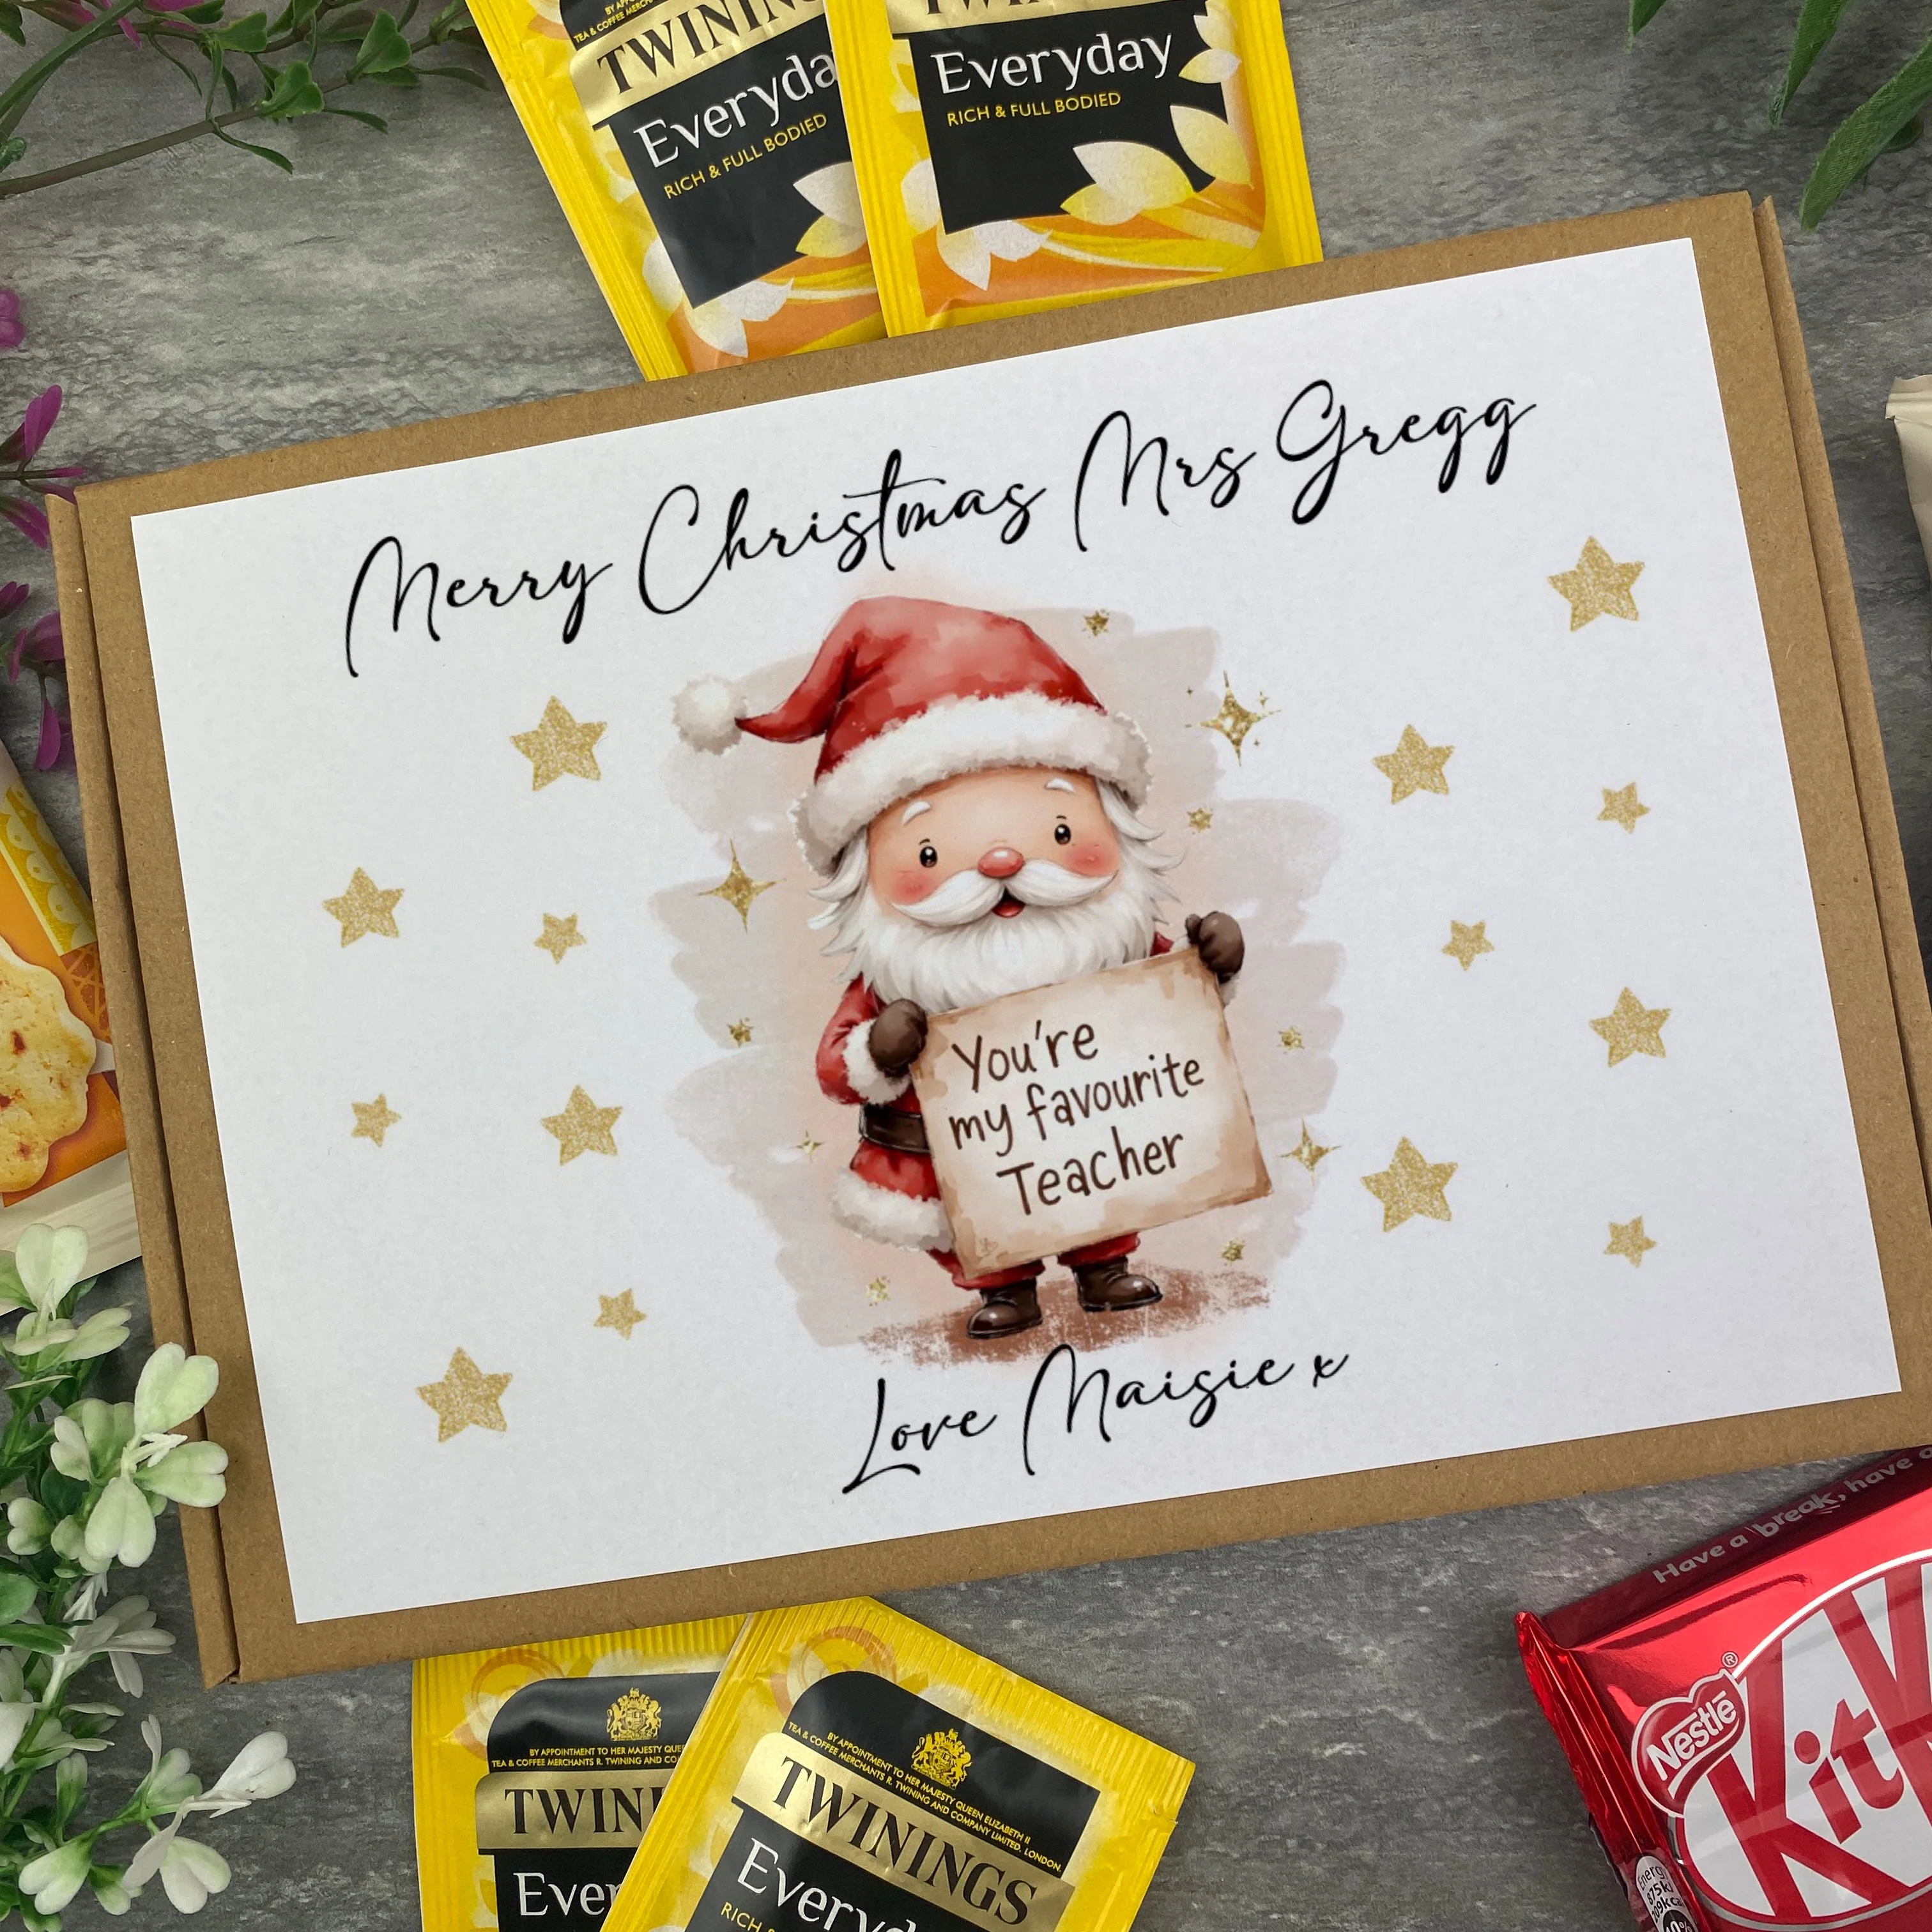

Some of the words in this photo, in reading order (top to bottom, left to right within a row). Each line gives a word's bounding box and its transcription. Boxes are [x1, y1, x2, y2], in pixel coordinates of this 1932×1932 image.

[574, 31, 590, 43] TEA
[597, 11, 625, 32] COFFEE
[931, 33, 1172, 94] Everyday
[947, 104, 990, 126] RICH
[995, 105, 1006, 118] &
[1011, 101, 1051, 117] FULL
[1055, 91, 1122, 114] BODIED
[664, 170, 706, 199] RICH
[708, 164, 721, 179] &
[722, 145, 763, 172] FULL
[763, 112, 827, 153] BODIED
[345, 536, 613, 677] Merry
[638, 448, 1046, 615] Christmas
[1075, 410, 1257, 552] Mrs
[1276, 379, 1537, 525] Gregg
[951, 1020, 1098, 1093] You're
[948, 1103, 1014, 1157] my
[1026, 1053, 1204, 1140] favourite
[996, 1126, 1183, 1216] Teacher
[842, 1378, 997, 1494] Love
[1022, 1344, 1295, 1476] Maisie
[1312, 1354, 1349, 1388] x
[1652, 1544, 1725, 1584] Have
[1729, 1533, 1749, 1548] a
[1843, 1457, 1913, 1494] have
[491, 1759, 507, 1768] TEA
[516, 1758, 546, 1767] COFFEE
[547, 1758, 594, 1767] MERCHANTS
[605, 1756, 642, 1766] TWINING
[643, 1756, 661, 1764] AND
[663, 1755, 679, 1764] CO
[529, 1748, 540, 1757] BY
[541, 1747, 595, 1756] APPOINTMENT
[597, 1747, 608, 1755] TO
[610, 1746, 625, 1755] HER
[627, 1745, 662, 1754] MAJESTY
[788, 1721, 802, 1736] TEA
[802, 1730, 809, 1740] &
[809, 1735, 839, 1756] COFFEE
[838, 1751, 885, 1781] MERCHANTS
[895, 1780, 931, 1804] TWINING
[930, 1801, 950, 1815] AND
[950, 1811, 992, 1836] COMPANY
[827, 1732, 839, 1743] BY
[838, 1738, 893, 1772] APPOINTMENT
[892, 1765, 904, 1779] TO
[905, 1773, 921, 1788] HER
[920, 1782, 956, 1805] MAJESTY
[955, 1800, 984, 1821] QUEEN
[984, 1816, 1025, 1841] ELIZABETH
[771, 1756, 1038, 1926] TWININGS
[721, 1901, 762, 1932] RICH
